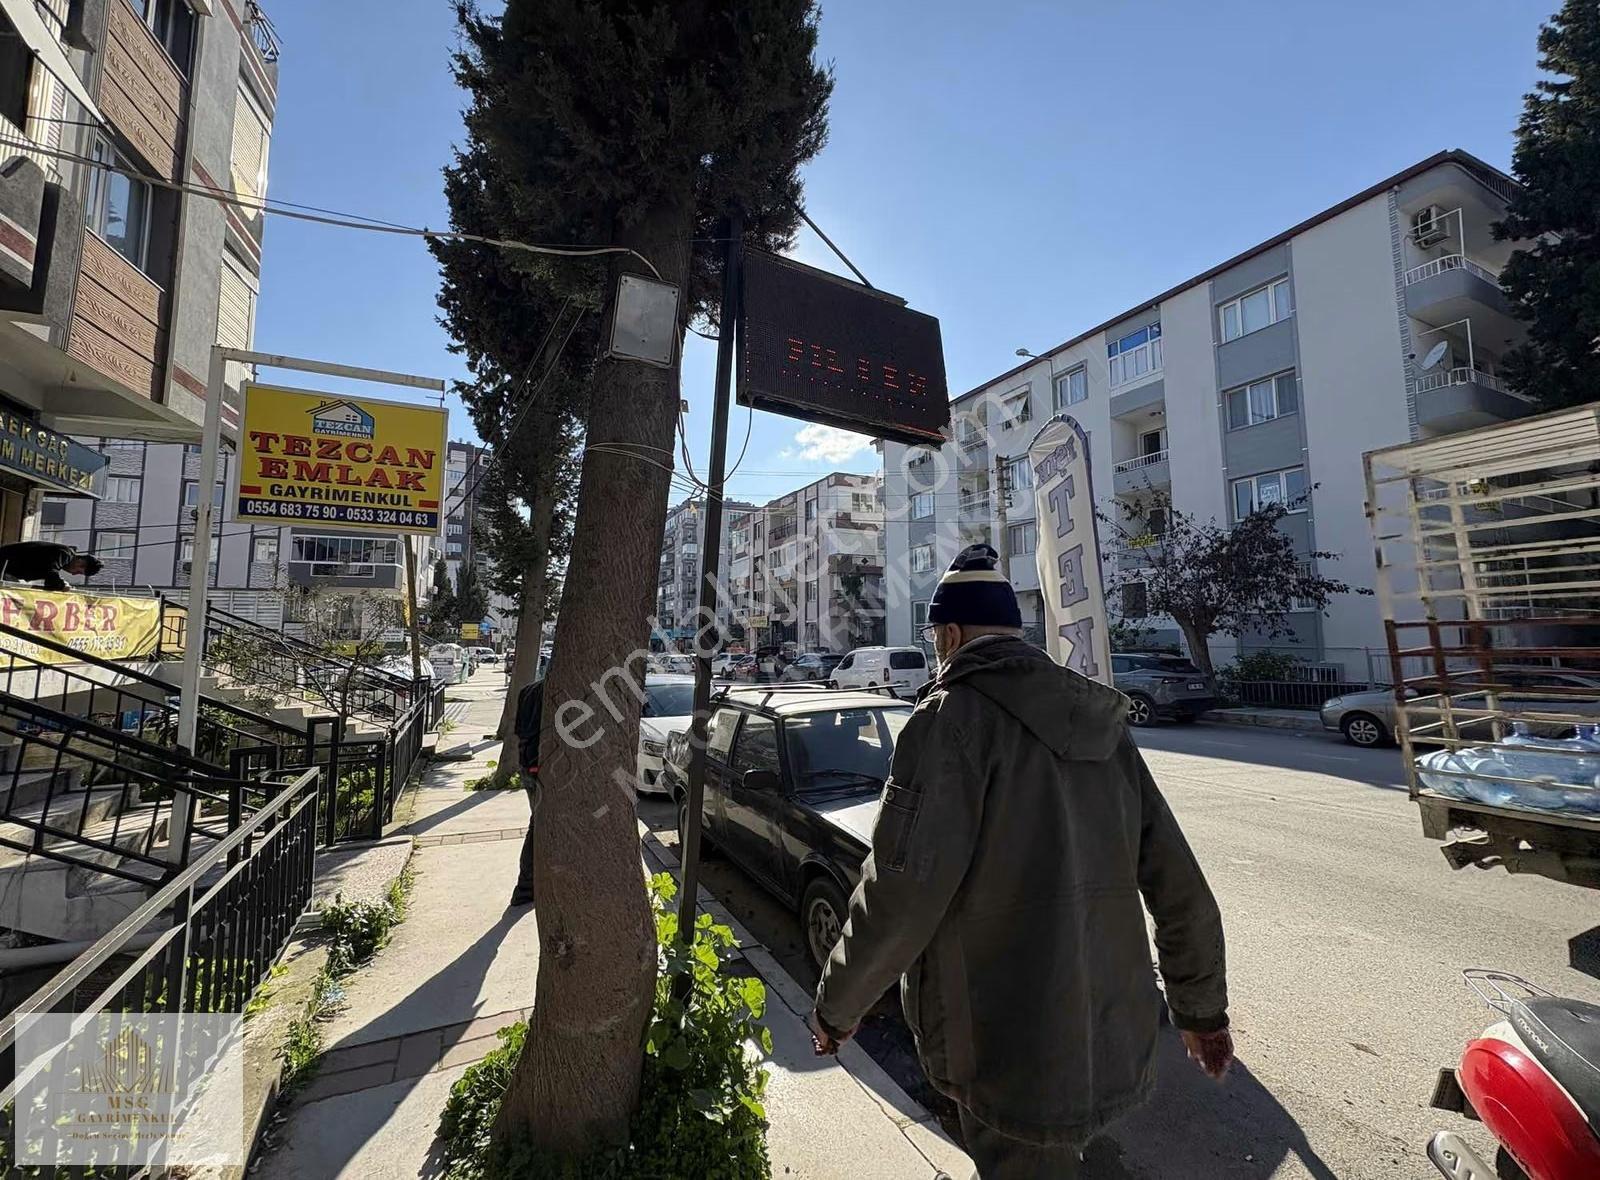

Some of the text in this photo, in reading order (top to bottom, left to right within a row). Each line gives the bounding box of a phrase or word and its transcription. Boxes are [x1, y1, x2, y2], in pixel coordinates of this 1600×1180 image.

[316, 420, 371, 433] TEZCAN
[249, 431, 436, 469] TEZCAN
[258, 457, 426, 492] EMLAK
[269, 483, 413, 507] GAYRİMENKUL
[247, 500, 277, 514] 0554
[280, 503, 302, 516] 683
[305, 505, 320, 518] 75
[322, 506, 337, 519] 90
[346, 508, 374, 521] 0533
[377, 510, 397, 523] 324
[400, 512, 412, 524] 04
[415, 513, 428, 525] 63
